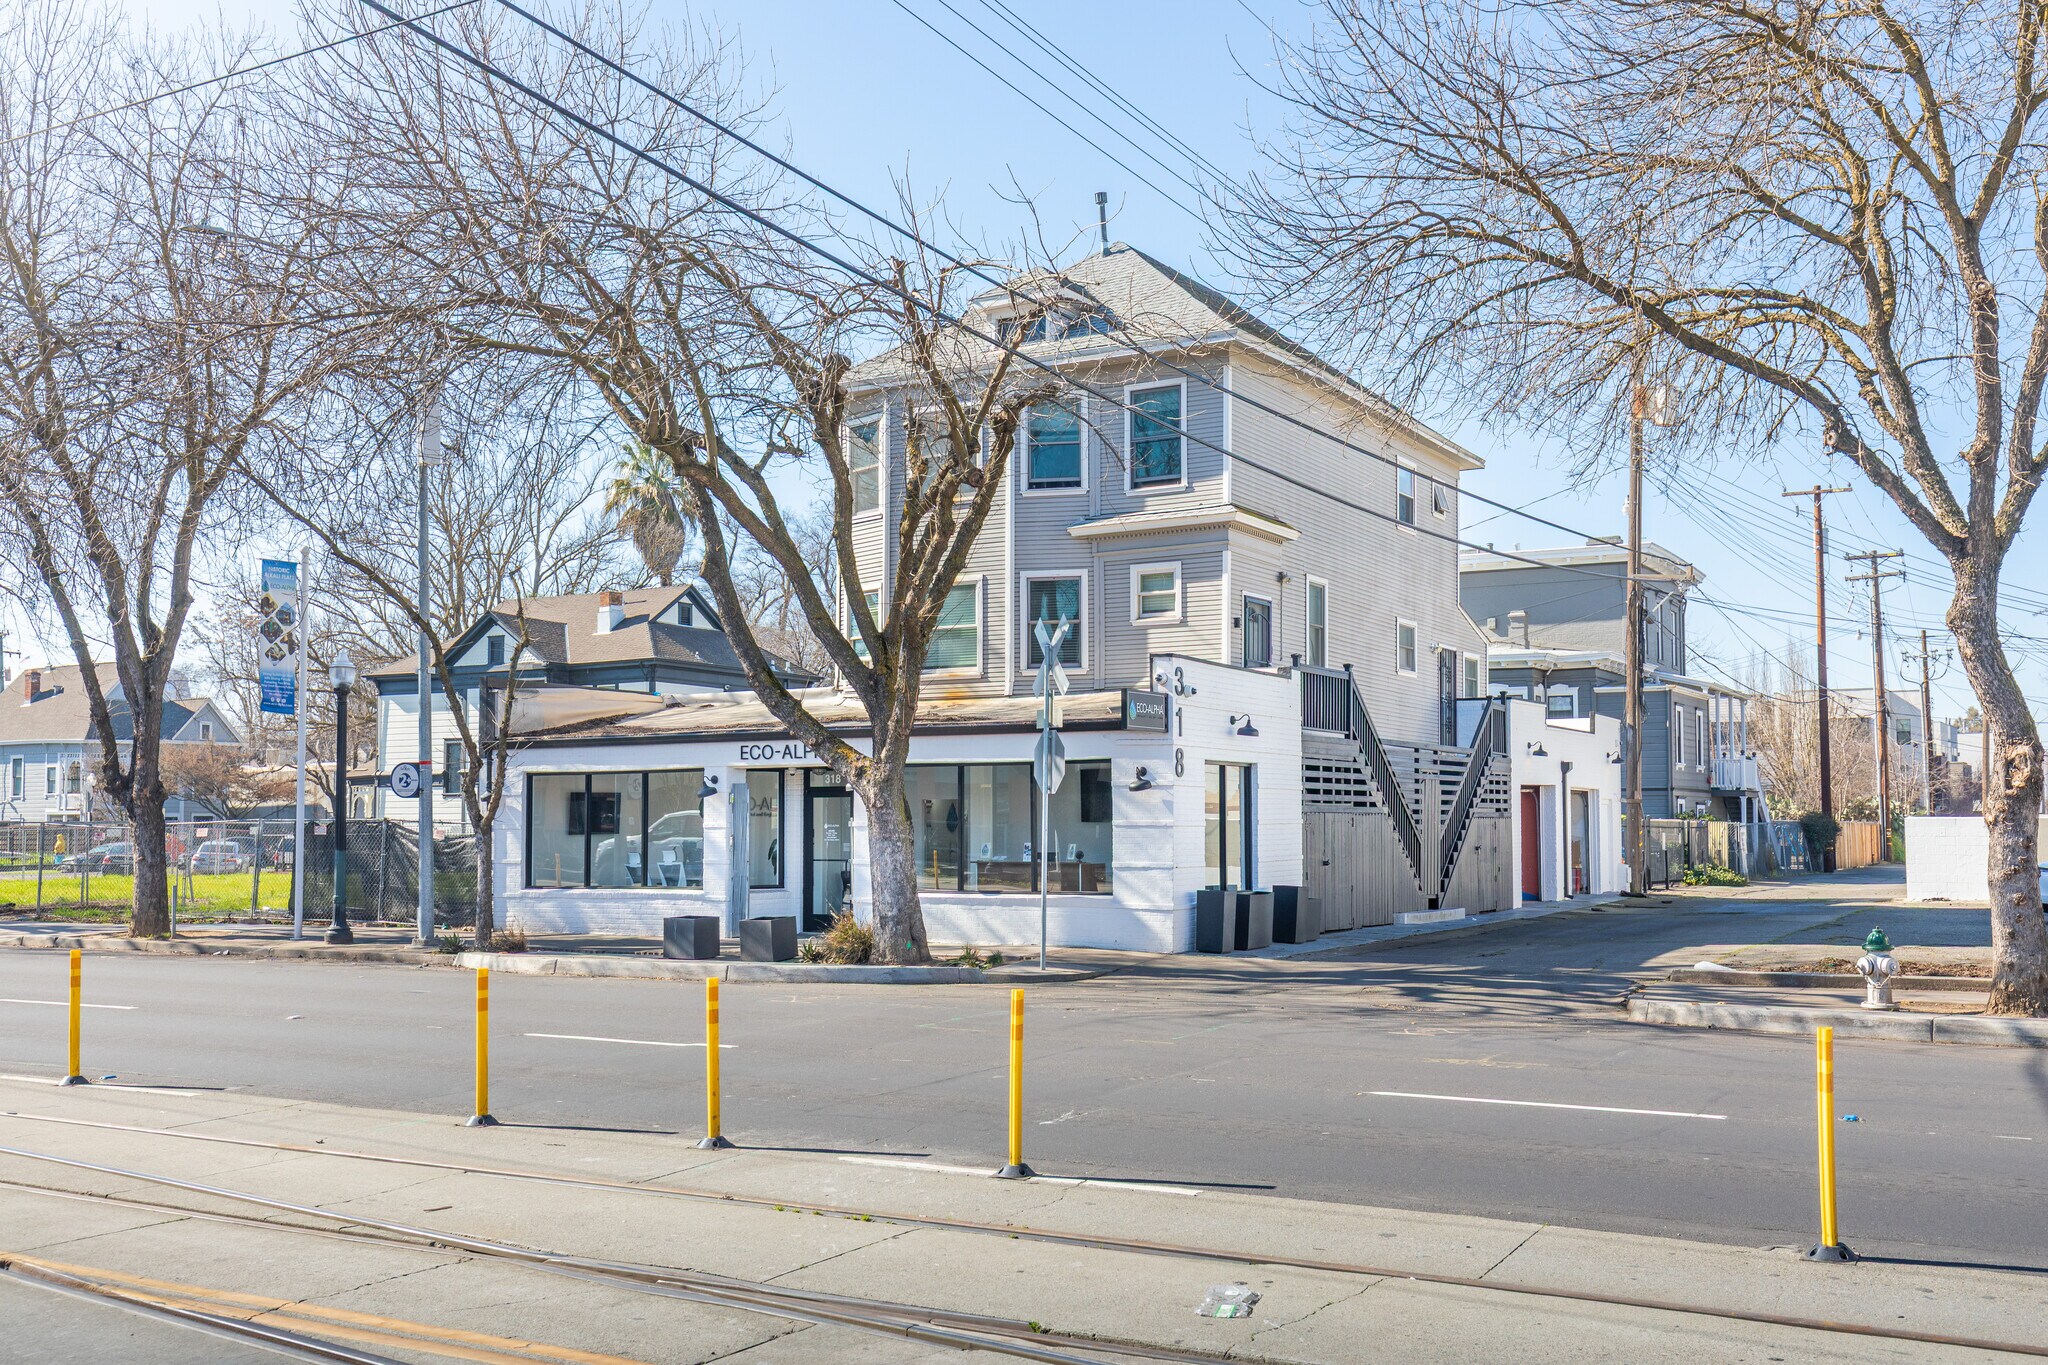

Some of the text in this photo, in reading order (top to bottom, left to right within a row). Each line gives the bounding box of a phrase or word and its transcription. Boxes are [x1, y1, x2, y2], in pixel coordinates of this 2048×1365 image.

[1136, 702, 1164, 715] ECO-ALPHA
[740, 744, 818, 760] ECO-ALP
[825, 774, 841, 784] 318
